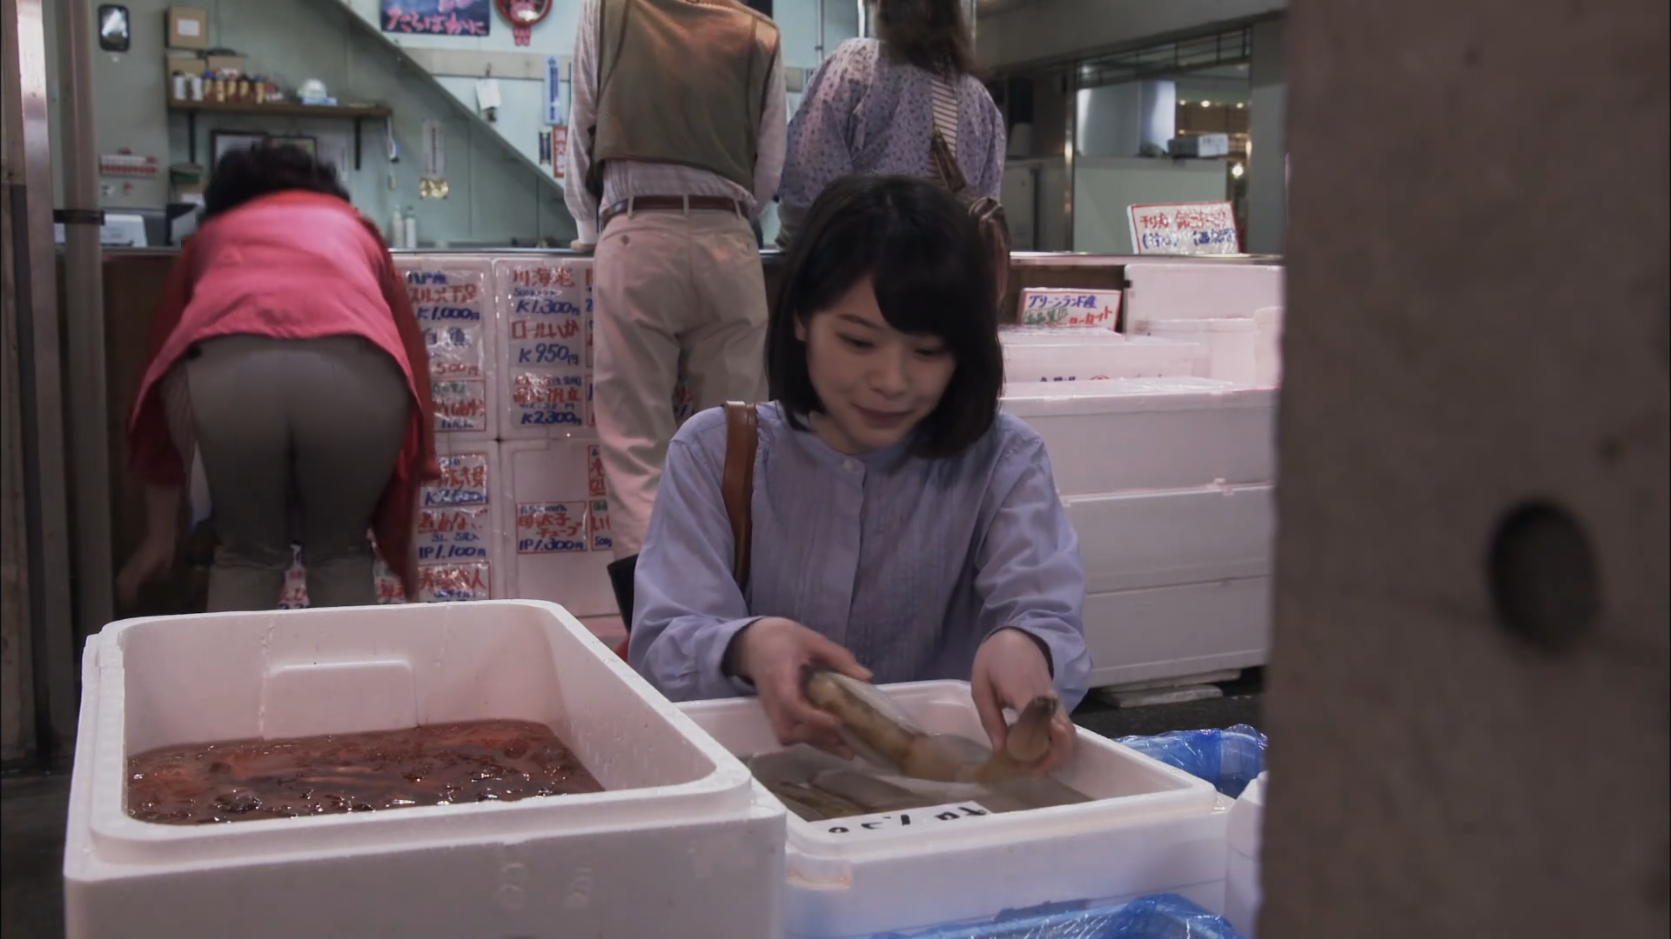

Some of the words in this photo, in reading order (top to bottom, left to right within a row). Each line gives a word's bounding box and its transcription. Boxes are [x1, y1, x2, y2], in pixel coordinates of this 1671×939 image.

[513, 266, 576, 288] 川海老
[1029, 294, 1097, 309] グリーンランド産
